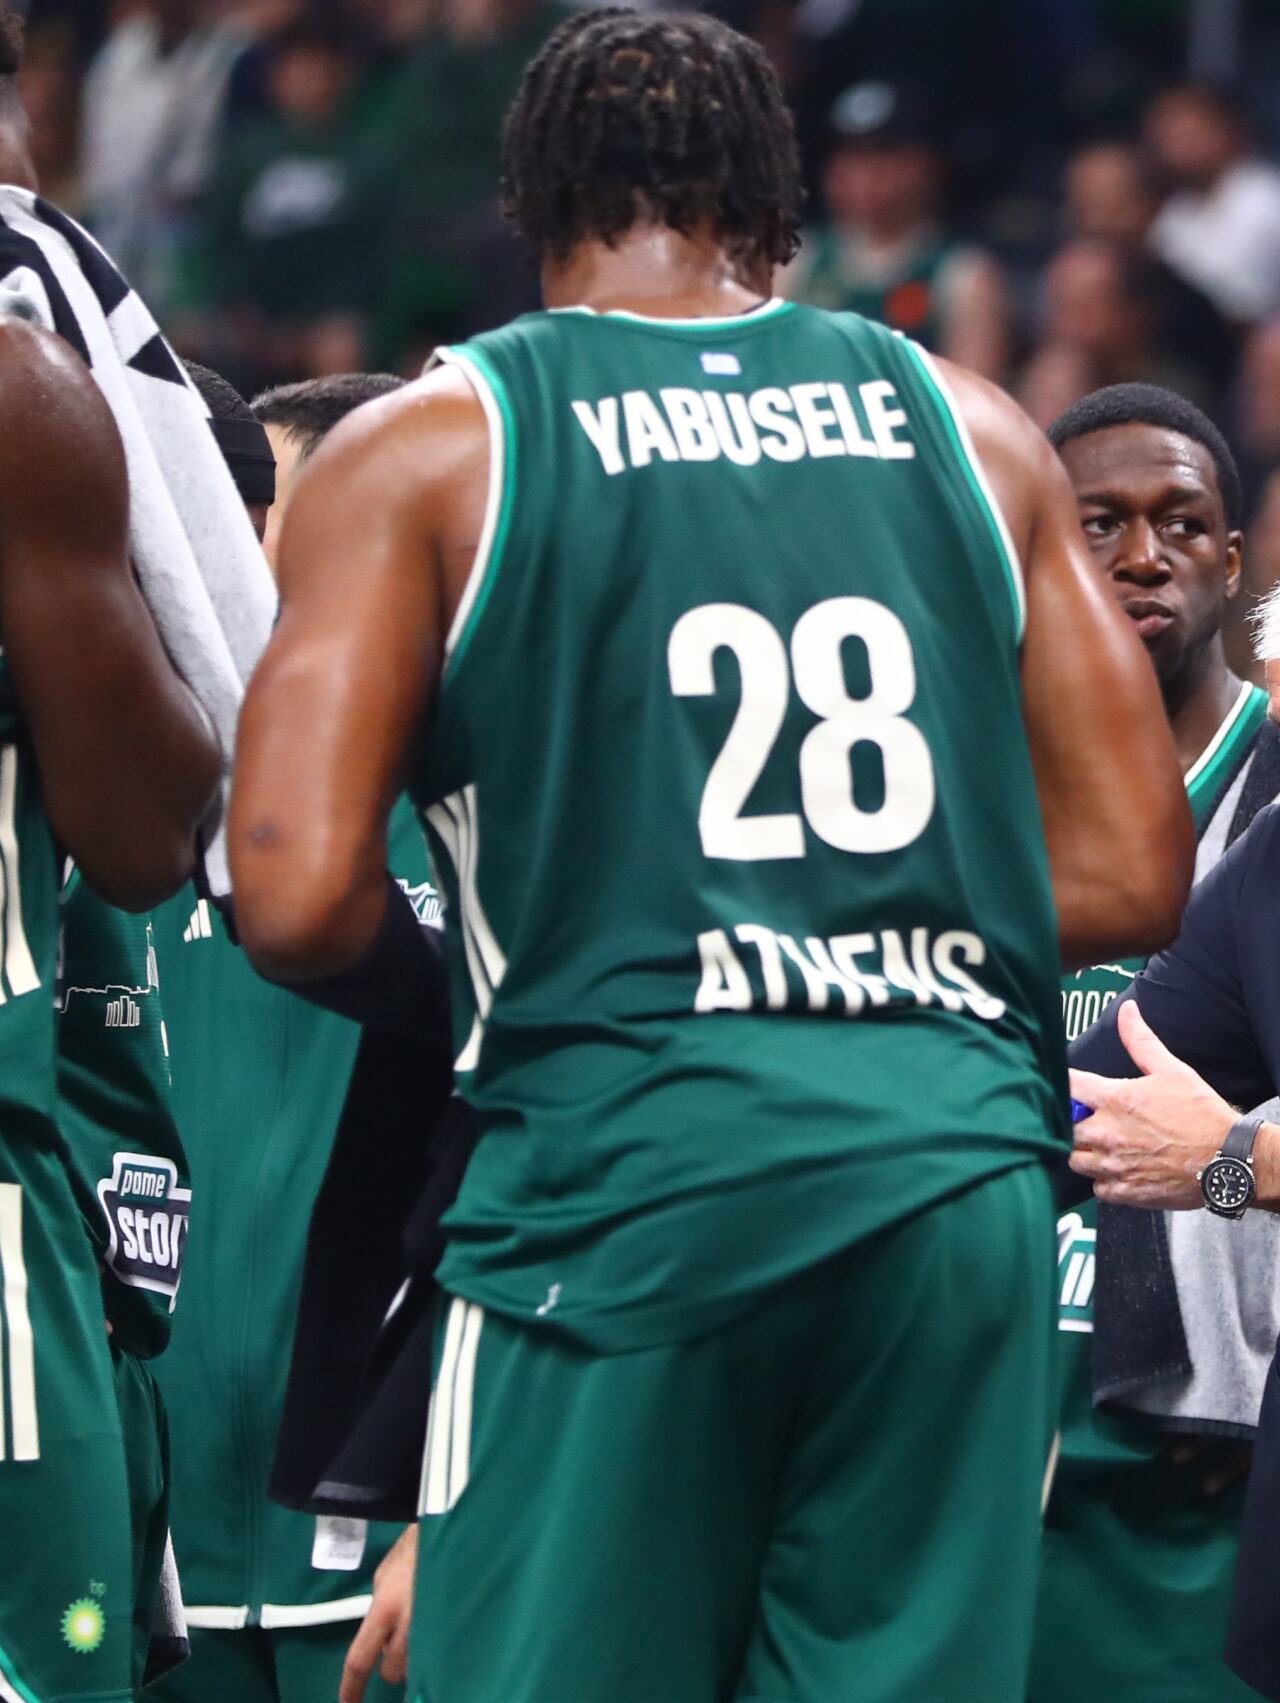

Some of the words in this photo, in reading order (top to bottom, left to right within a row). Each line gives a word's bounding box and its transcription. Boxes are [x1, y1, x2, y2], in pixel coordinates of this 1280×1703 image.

[571, 380, 915, 476] YABUSELE
[667, 596, 935, 861] 28
[694, 923, 1006, 1020] ATHENS
[120, 1169, 166, 1198] pame
[89, 1579, 107, 1599] bp
